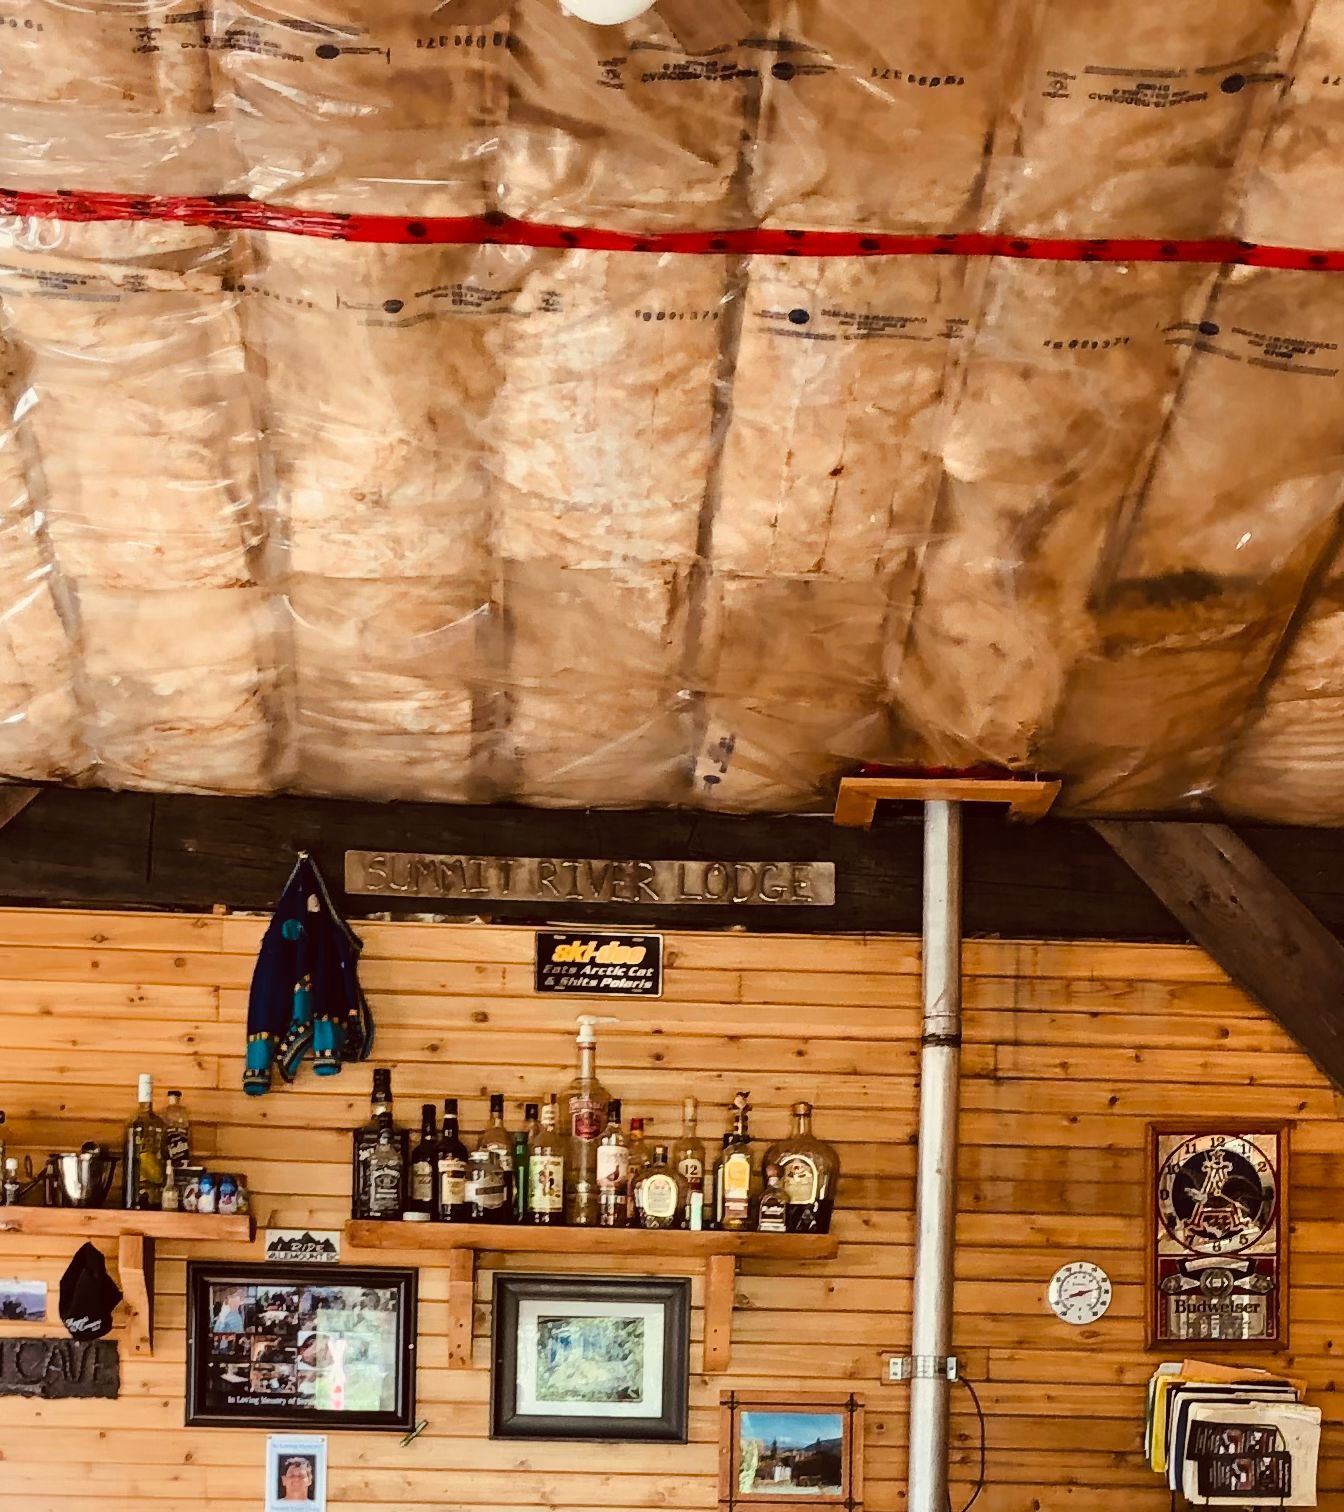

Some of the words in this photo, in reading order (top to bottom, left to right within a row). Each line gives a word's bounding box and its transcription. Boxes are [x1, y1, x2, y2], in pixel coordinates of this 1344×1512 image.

[366, 855, 516, 895] SUMMIT
[536, 860, 659, 901] RIVER
[677, 862, 814, 902] LODGE
[551, 940, 647, 965] ski-doo
[542, 964, 578, 974] Eats
[580, 965, 627, 976] Arctic
[627, 966, 654, 977] Cat
[560, 976, 598, 987] Shits
[600, 977, 653, 989] Polaris
[1210, 1136, 1226, 1148] 12
[685, 1164, 698, 1176] 12
[1257, 1161, 1267, 1173] 2
[1174, 1299, 1261, 1314] Budweiser
